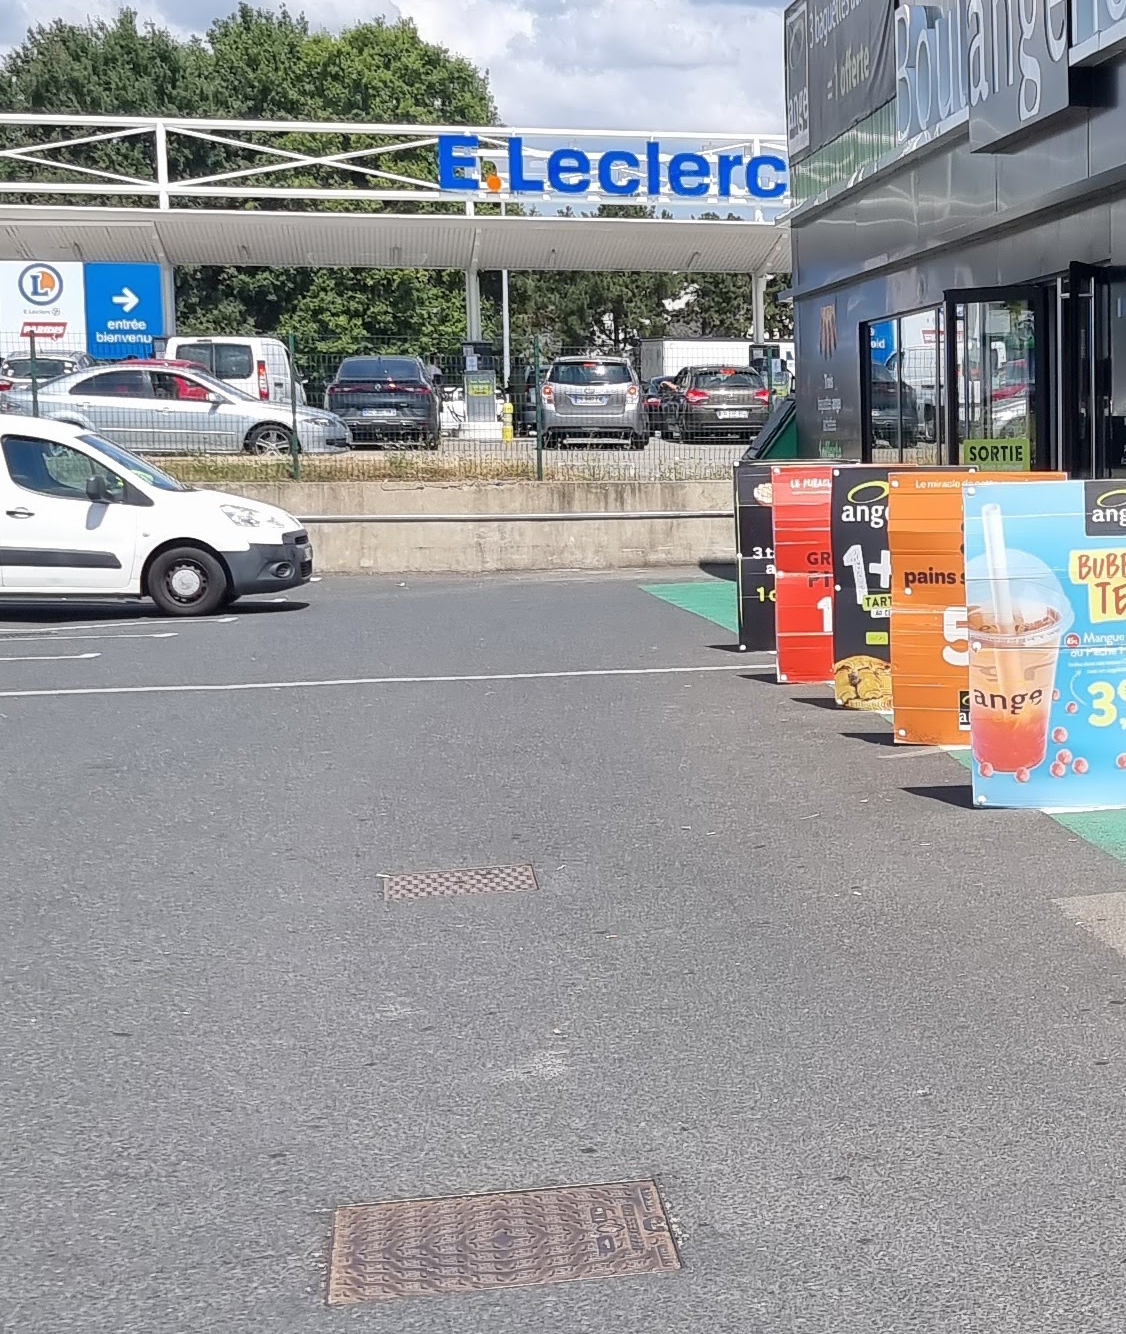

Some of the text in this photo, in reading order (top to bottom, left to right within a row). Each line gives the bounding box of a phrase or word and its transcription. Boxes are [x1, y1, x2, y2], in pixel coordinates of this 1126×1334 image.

[809, 9, 814, 49] 3
[840, 44, 870, 96] offerte
[438, 134, 788, 199] E.Leclerc
[107, 319, 147, 330] entrée
[969, 445, 1023, 462] SORTIE
[904, 567, 956, 588] pains
[1083, 632, 1125, 646] Mangue
[973, 688, 1043, 716] ange
